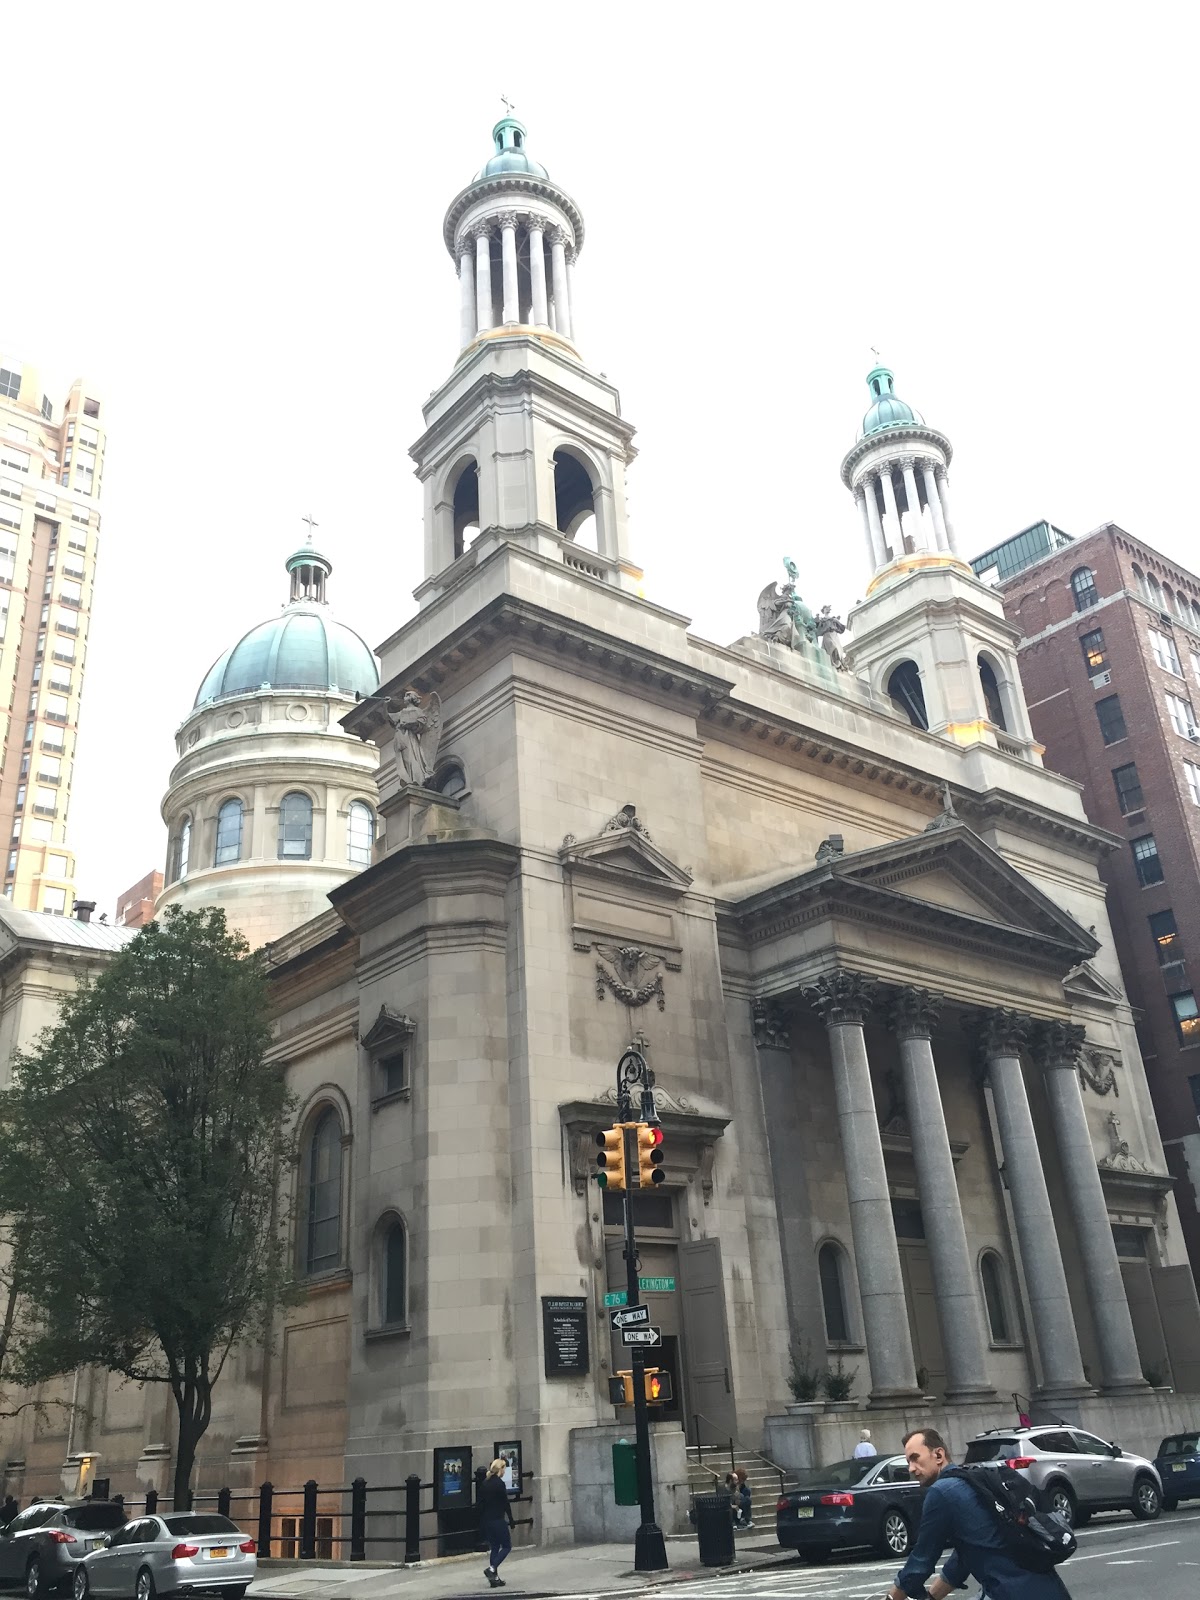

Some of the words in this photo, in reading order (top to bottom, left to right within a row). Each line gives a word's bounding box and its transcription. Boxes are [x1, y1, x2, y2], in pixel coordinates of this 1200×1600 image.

[639, 1278, 669, 1290] LEXINGTON
[604, 1295, 610, 1306] E
[612, 1294, 621, 1304] 76
[616, 1314, 628, 1324] ONE
[632, 1311, 644, 1321] WAY
[627, 1333, 639, 1341] ONE
[643, 1333, 655, 1341] WAY
